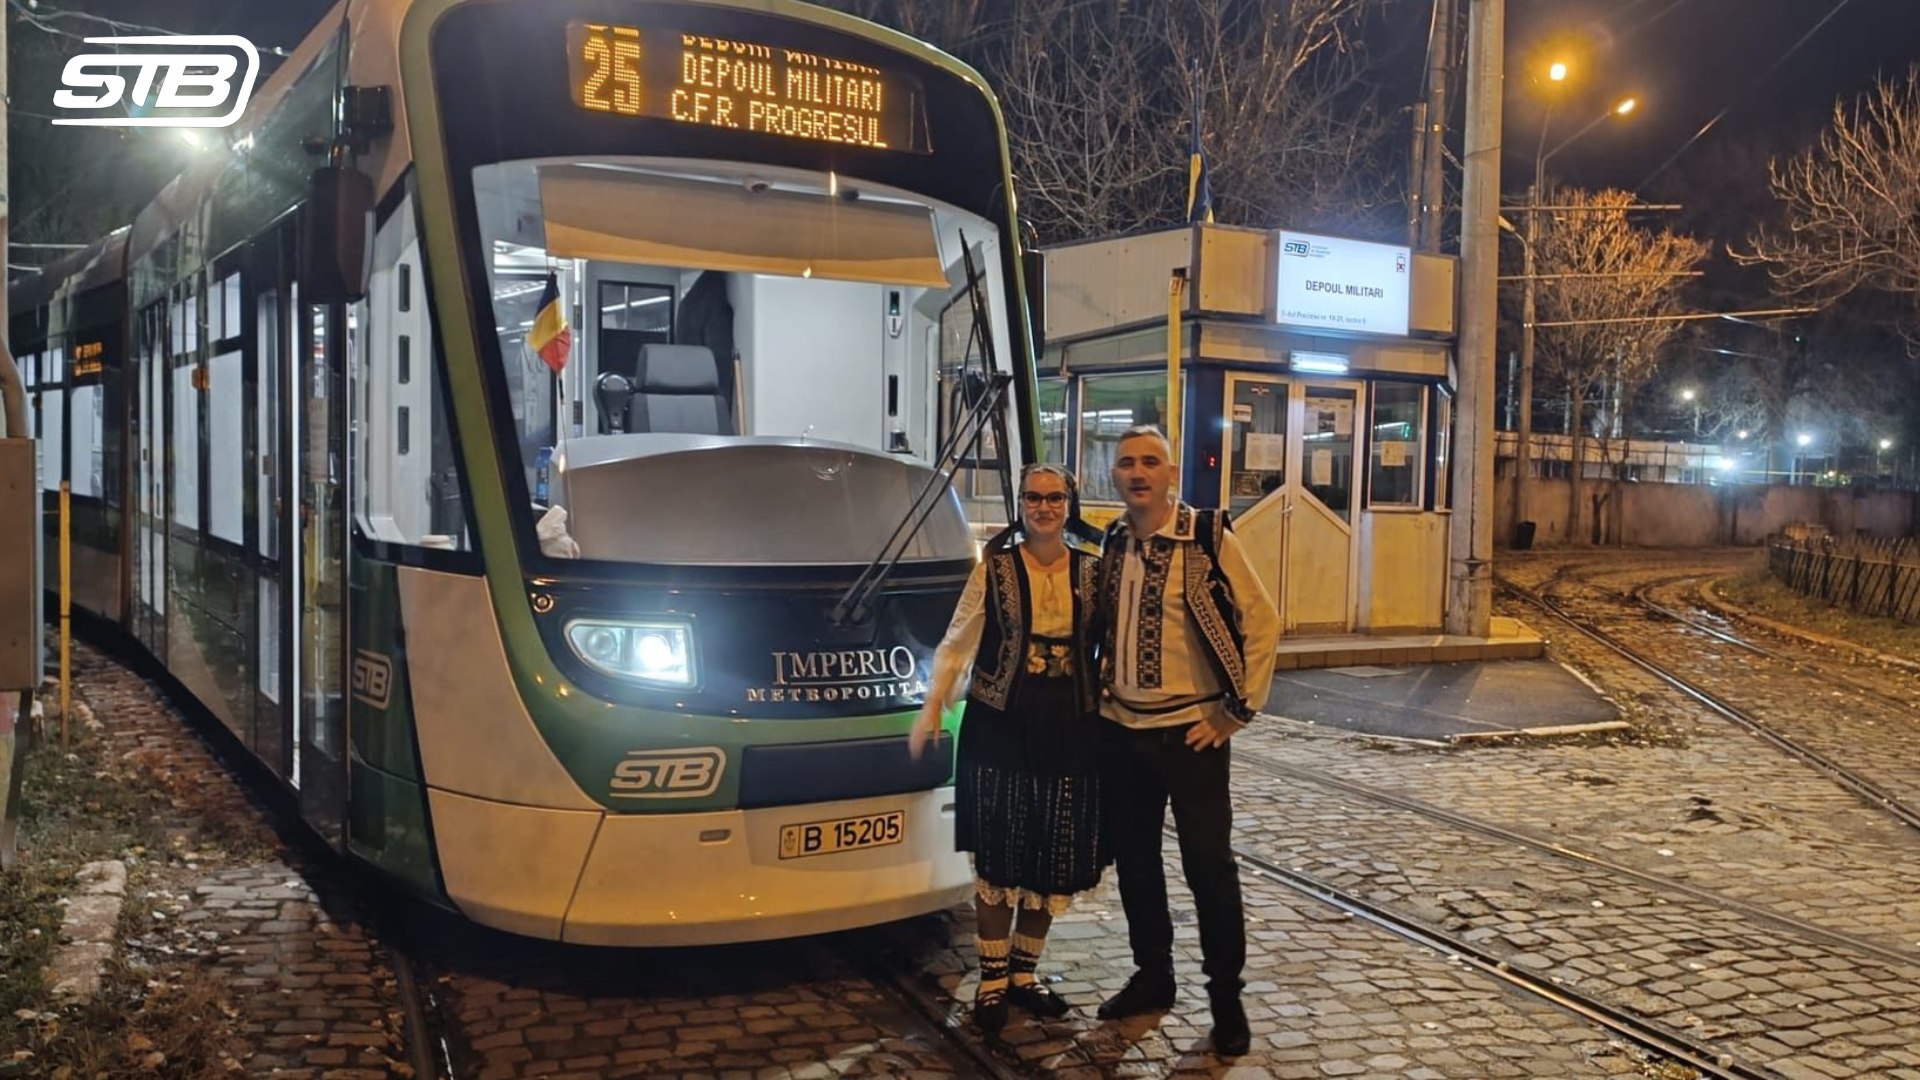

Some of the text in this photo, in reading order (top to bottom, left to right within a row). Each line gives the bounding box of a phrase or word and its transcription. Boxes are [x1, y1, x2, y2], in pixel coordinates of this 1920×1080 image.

[583, 34, 641, 114] 25
[683, 51, 776, 97] DEPOUL
[786, 68, 882, 112] MILITARI
[671, 89, 887, 148] C.F.R. PROGRESUL
[1284, 241, 1309, 255] STB
[1306, 279, 1384, 299] DEPOUL MILITARI
[352, 656, 389, 700] STB
[771, 645, 916, 686] IMPERIO
[746, 680, 930, 702] METROPOLITA
[609, 755, 716, 791] STB
[804, 815, 900, 852] B 15205
